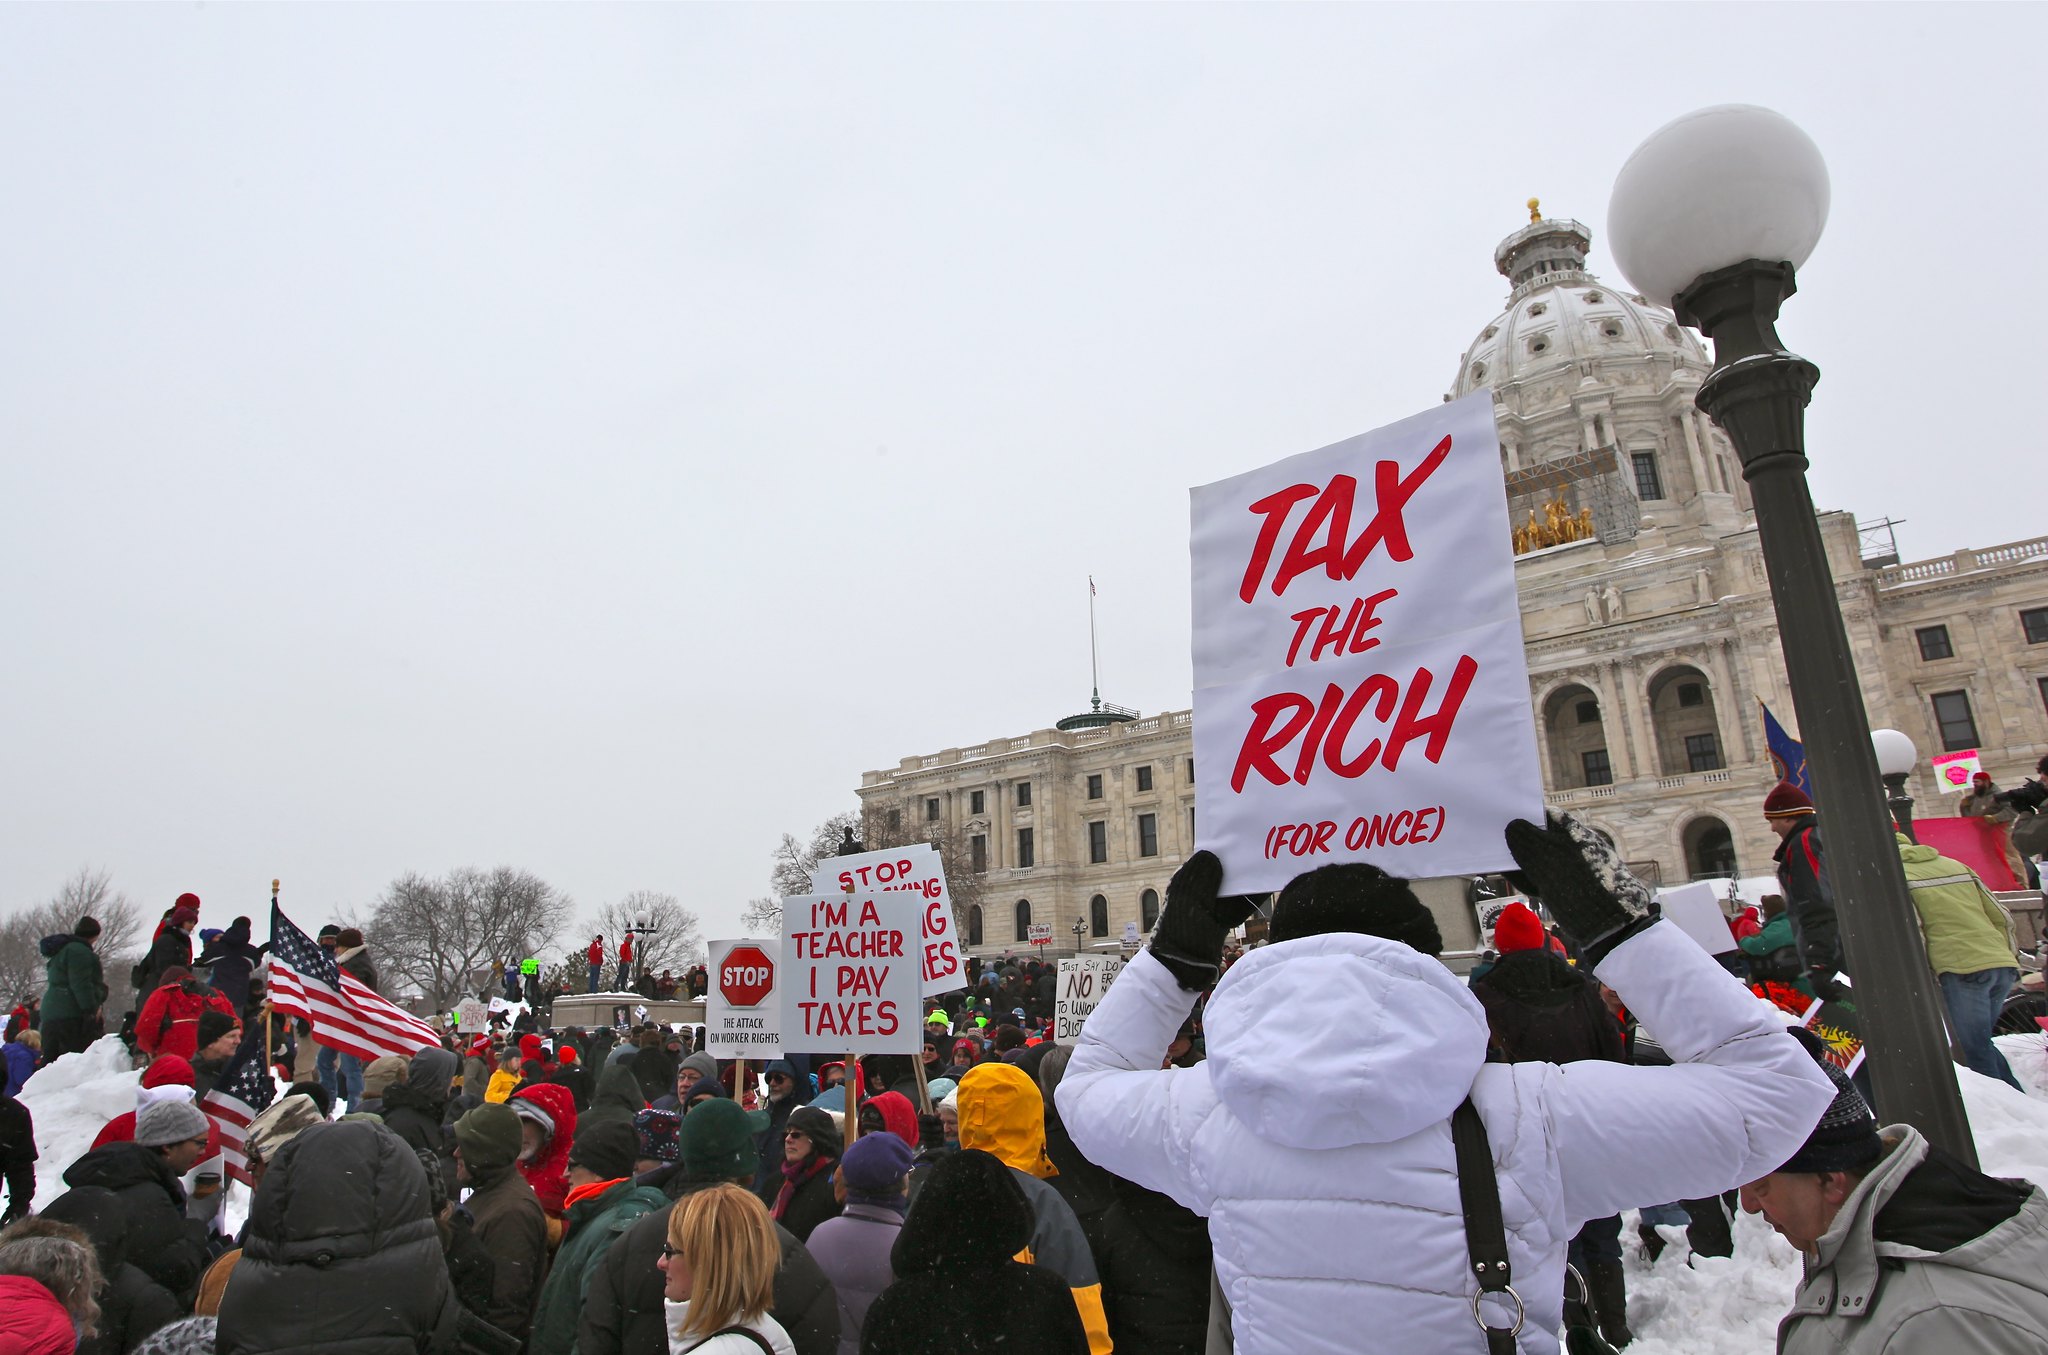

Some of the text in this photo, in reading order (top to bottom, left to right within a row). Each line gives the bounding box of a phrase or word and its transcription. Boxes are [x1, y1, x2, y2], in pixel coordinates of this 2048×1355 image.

[1239, 434, 1453, 605] TAX
[1285, 588, 1399, 668] THE
[1231, 655, 1479, 794] RICH
[1265, 806, 1446, 859] (FOR ONCE)
[838, 859, 913, 892] STOP
[811, 900, 881, 929] I'M A
[791, 930, 904, 959] TEACHER
[723, 966, 769, 987] STOP
[1083, 960, 1101, 972] SAY
[810, 966, 889, 998] I PAY
[1066, 971, 1093, 999] NO
[723, 1018, 764, 1029] THE ATTACK
[798, 1001, 899, 1036] TAXES
[1057, 1016, 1086, 1039] BUST
[710, 1033, 780, 1043] ON WORKER RIGHTS
